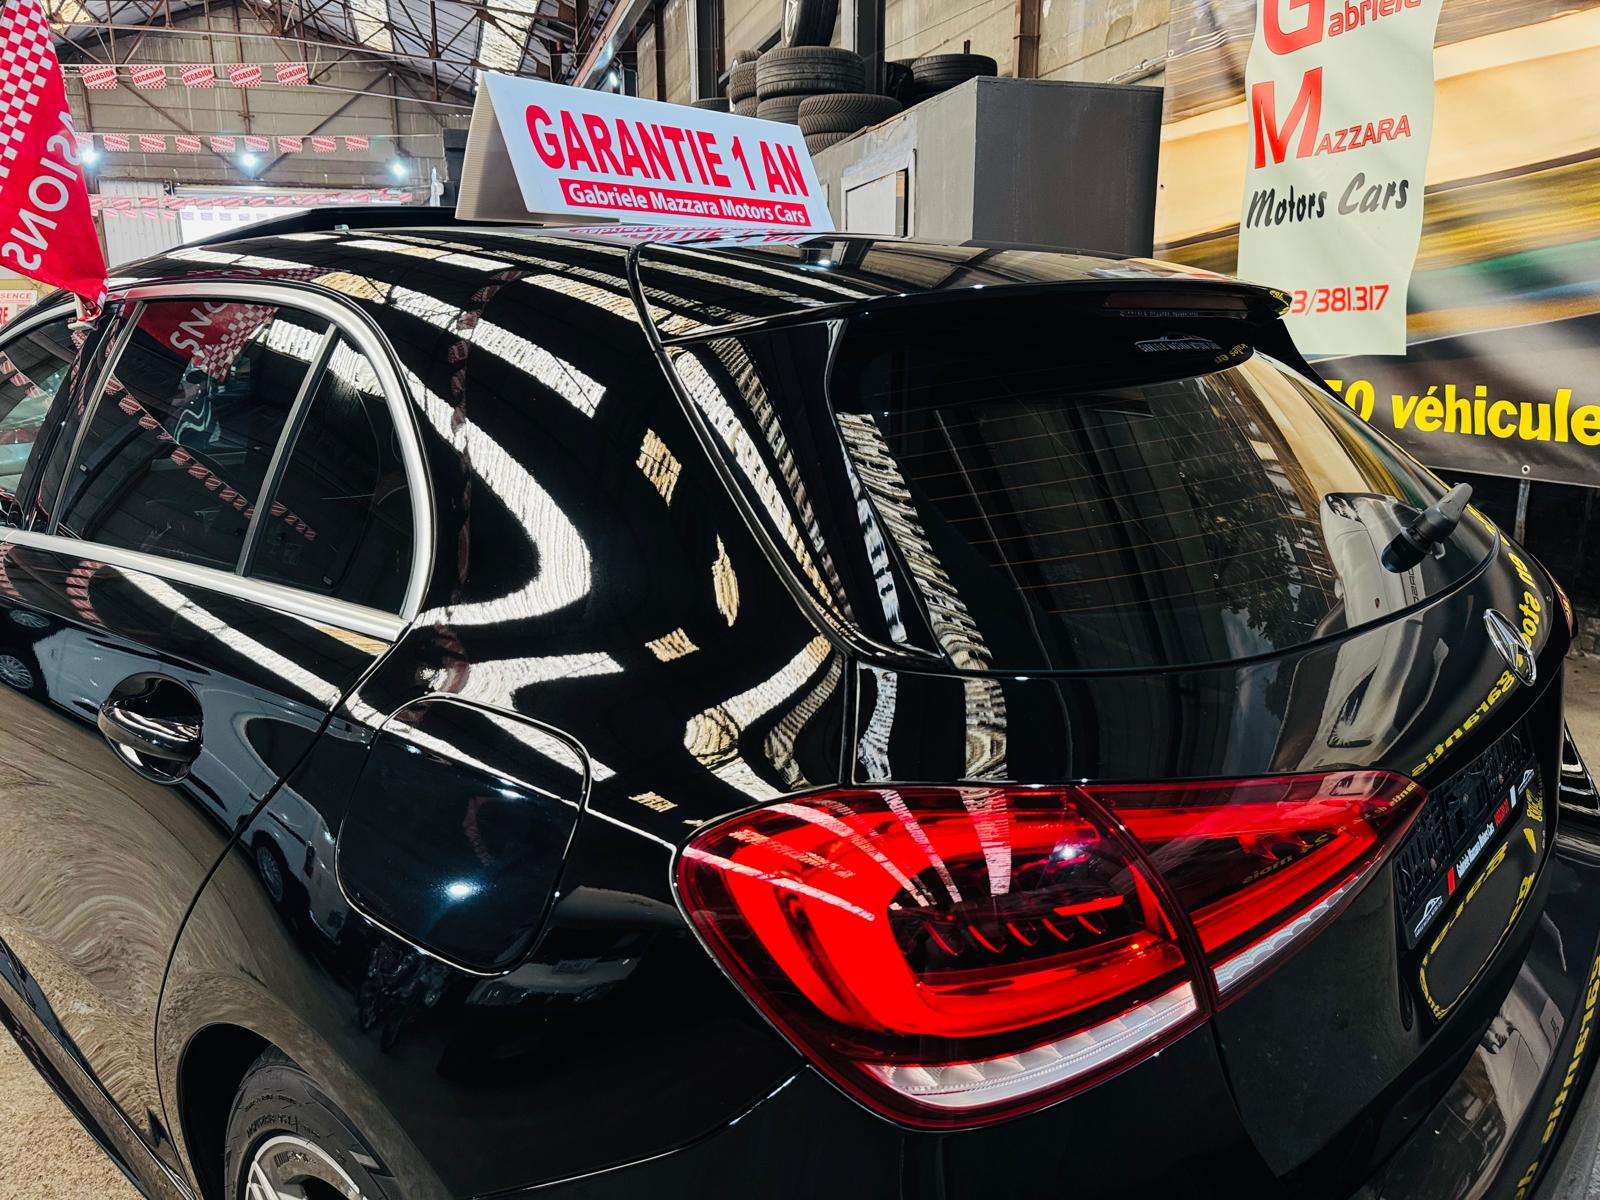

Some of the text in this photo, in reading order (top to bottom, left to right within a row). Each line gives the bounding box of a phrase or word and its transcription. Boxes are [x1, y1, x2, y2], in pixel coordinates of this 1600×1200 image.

[525, 104, 810, 197] GARANTIE 1 AN
[568, 182, 805, 223] Gabriele Mazzara Motors Cars
[1246, 172, 1409, 229] Motors Cars
[1324, 380, 1375, 423] 0
